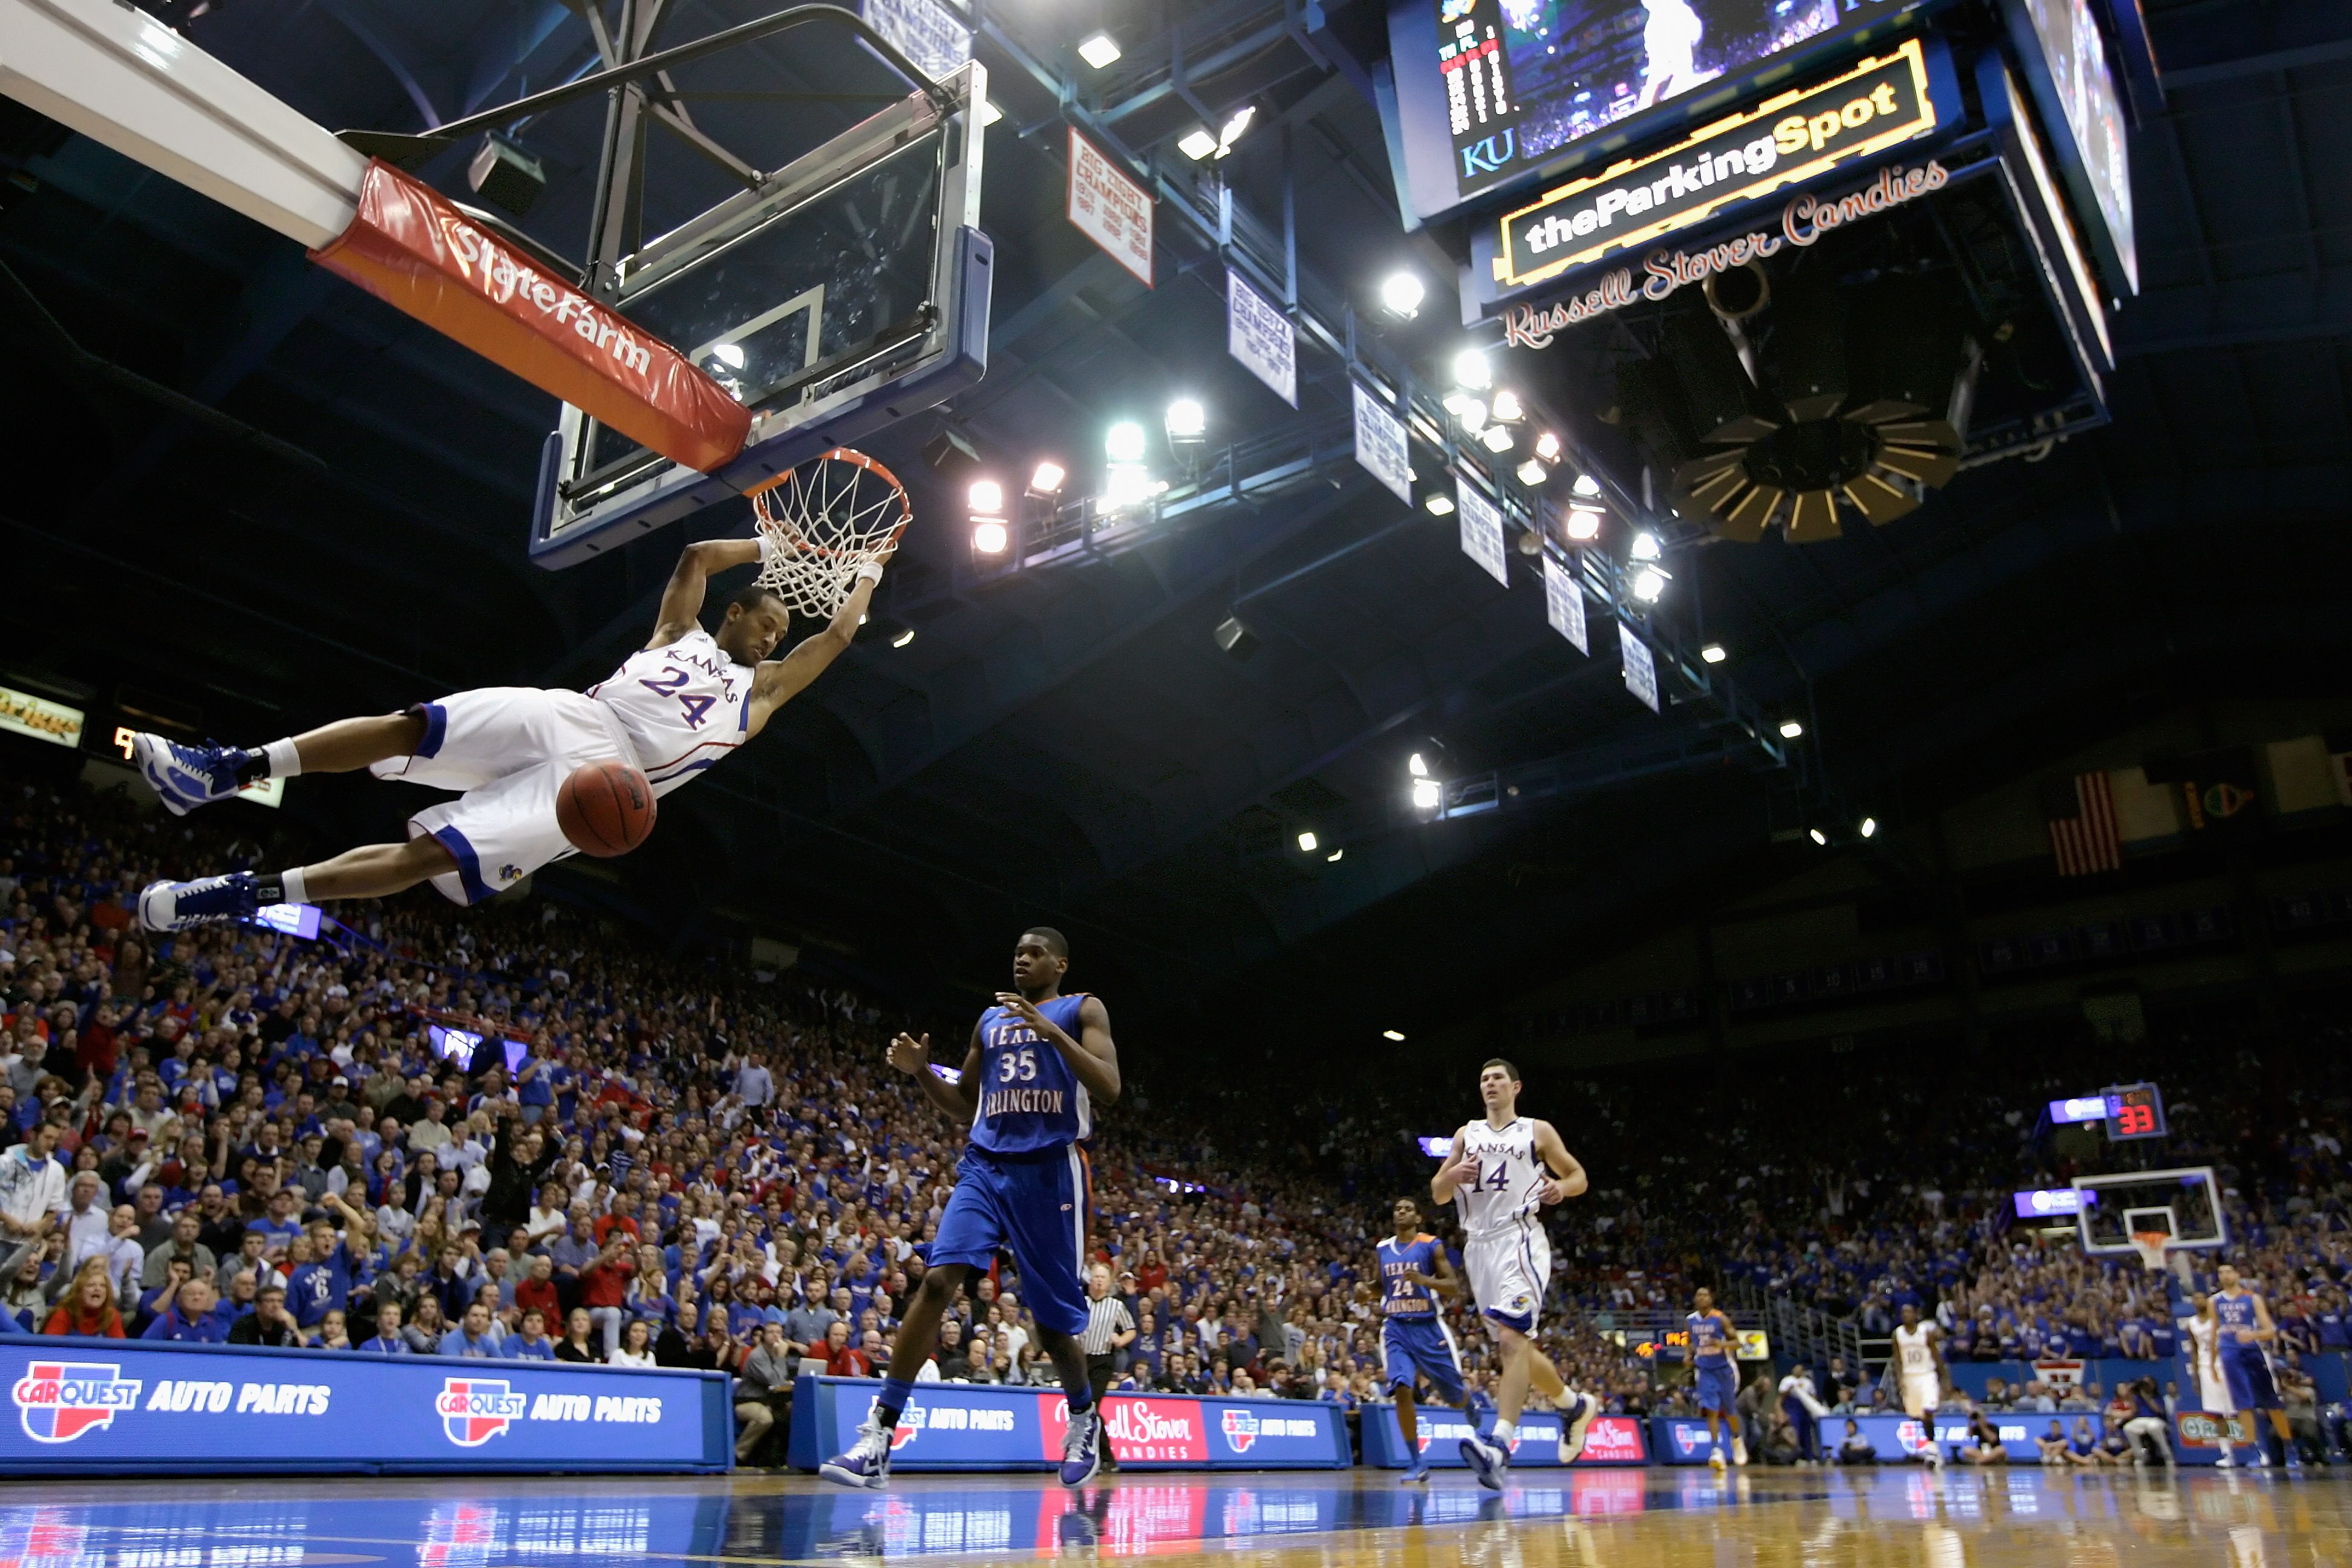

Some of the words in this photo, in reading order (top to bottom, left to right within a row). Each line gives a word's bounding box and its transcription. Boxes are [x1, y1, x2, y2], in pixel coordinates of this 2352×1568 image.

[1082, 145, 1103, 176] BIG
[1461, 128, 1514, 178] KU
[1525, 82, 1897, 254] theParkingSpot
[1077, 159, 1147, 233] CHAMPIONS
[1500, 267, 1638, 350] Russell
[1642, 232, 1780, 301] Stover
[1782, 160, 1949, 246] Candies
[665, 650, 738, 704] KANSAS
[639, 666, 717, 731] 24
[999, 1050, 1037, 1083] 35
[2117, 1105, 2155, 1134] 33
[1472, 1160, 1510, 1193] 14
[315, 1276, 328, 1299] 6
[1392, 1278, 1414, 1297] 24
[1907, 1350, 1922, 1365] 10
[17, 1380, 137, 1405] CARQUEST
[146, 1380, 232, 1412] AUTO
[236, 1383, 331, 1415] PARTS
[440, 1394, 524, 1414] CARQUEST
[530, 1394, 592, 1421] AUTO
[593, 1396, 662, 1423] PARTS
[929, 1408, 968, 1429] AUTO
[970, 1409, 1014, 1431] PARTS
[1133, 1401, 1192, 1443] Stover
[1111, 1446, 1188, 1459] ANDIES
